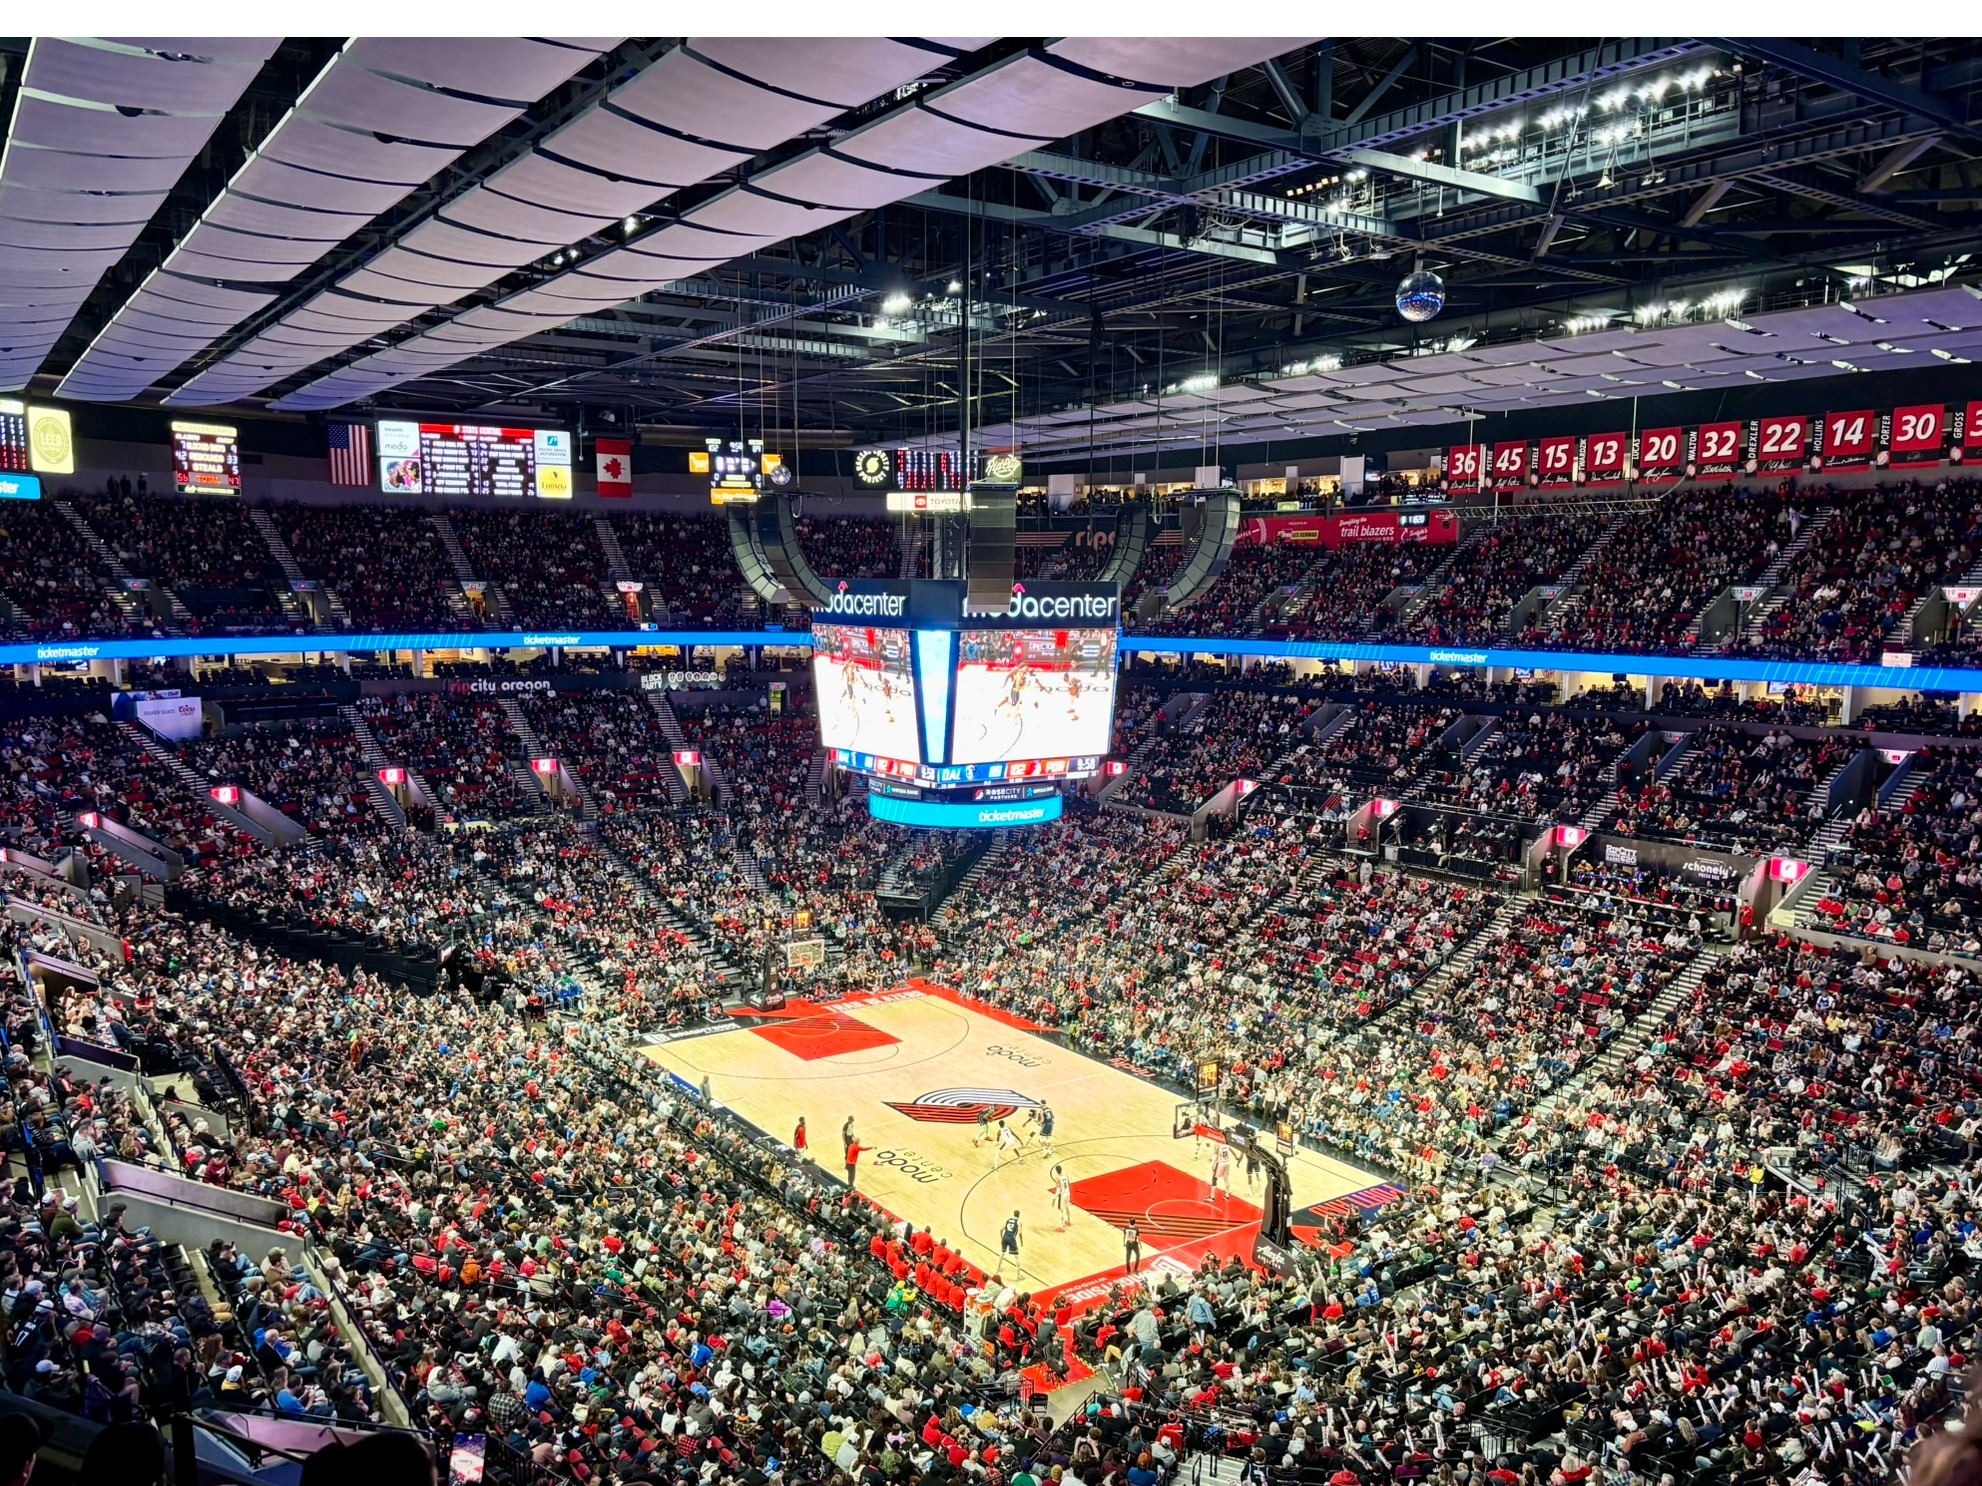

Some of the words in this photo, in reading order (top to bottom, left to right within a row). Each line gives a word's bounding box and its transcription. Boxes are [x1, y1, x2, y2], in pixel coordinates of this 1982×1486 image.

[1813, 419, 1824, 452] HOLLINS
[1832, 417, 1865, 447] 14
[1880, 415, 1891, 445] PORTER
[1896, 413, 1936, 442] 30
[1953, 411, 1964, 439] GROSS
[1632, 438, 1640, 460] LUCAS
[1644, 434, 1677, 462] 20
[1687, 431, 1698, 461] WALTON
[1702, 430, 1737, 458] 32
[1748, 420, 1759, 459] DREXLER
[1762, 422, 1801, 453] 22
[175, 450, 187, 460] 42
[227, 454, 238, 464] 33
[1451, 451, 1477, 475] 36
[1486, 450, 1494, 471] PETRIE
[1496, 447, 1524, 472] 45
[1545, 444, 1570, 469] 15
[1578, 438, 1587, 471] TWARDZIK
[1593, 440, 1619, 466] 13
[178, 473, 189, 482] 56
[195, 474, 222, 484] TOTAL
[228, 477, 239, 485] 47
[1341, 526, 1359, 537] trail
[1360, 525, 1395, 536] blazers
[962, 591, 1117, 618] dacenter
[524, 635, 581, 645] ticketmaster
[37, 646, 100, 659] ticketmaster
[1430, 650, 1488, 663] ticketmaster
[641, 673, 662, 683] BLOCK
[641, 681, 662, 691] PARTY
[1077, 758, 1096, 770] 9:58
[978, 808, 1045, 823] ticketmaster
[1683, 860, 1738, 880] schonely's
[987, 1045, 1041, 1068] moda
[876, 1149, 939, 1183] moda
[1058, 1277, 1109, 1296] WINDOWS
